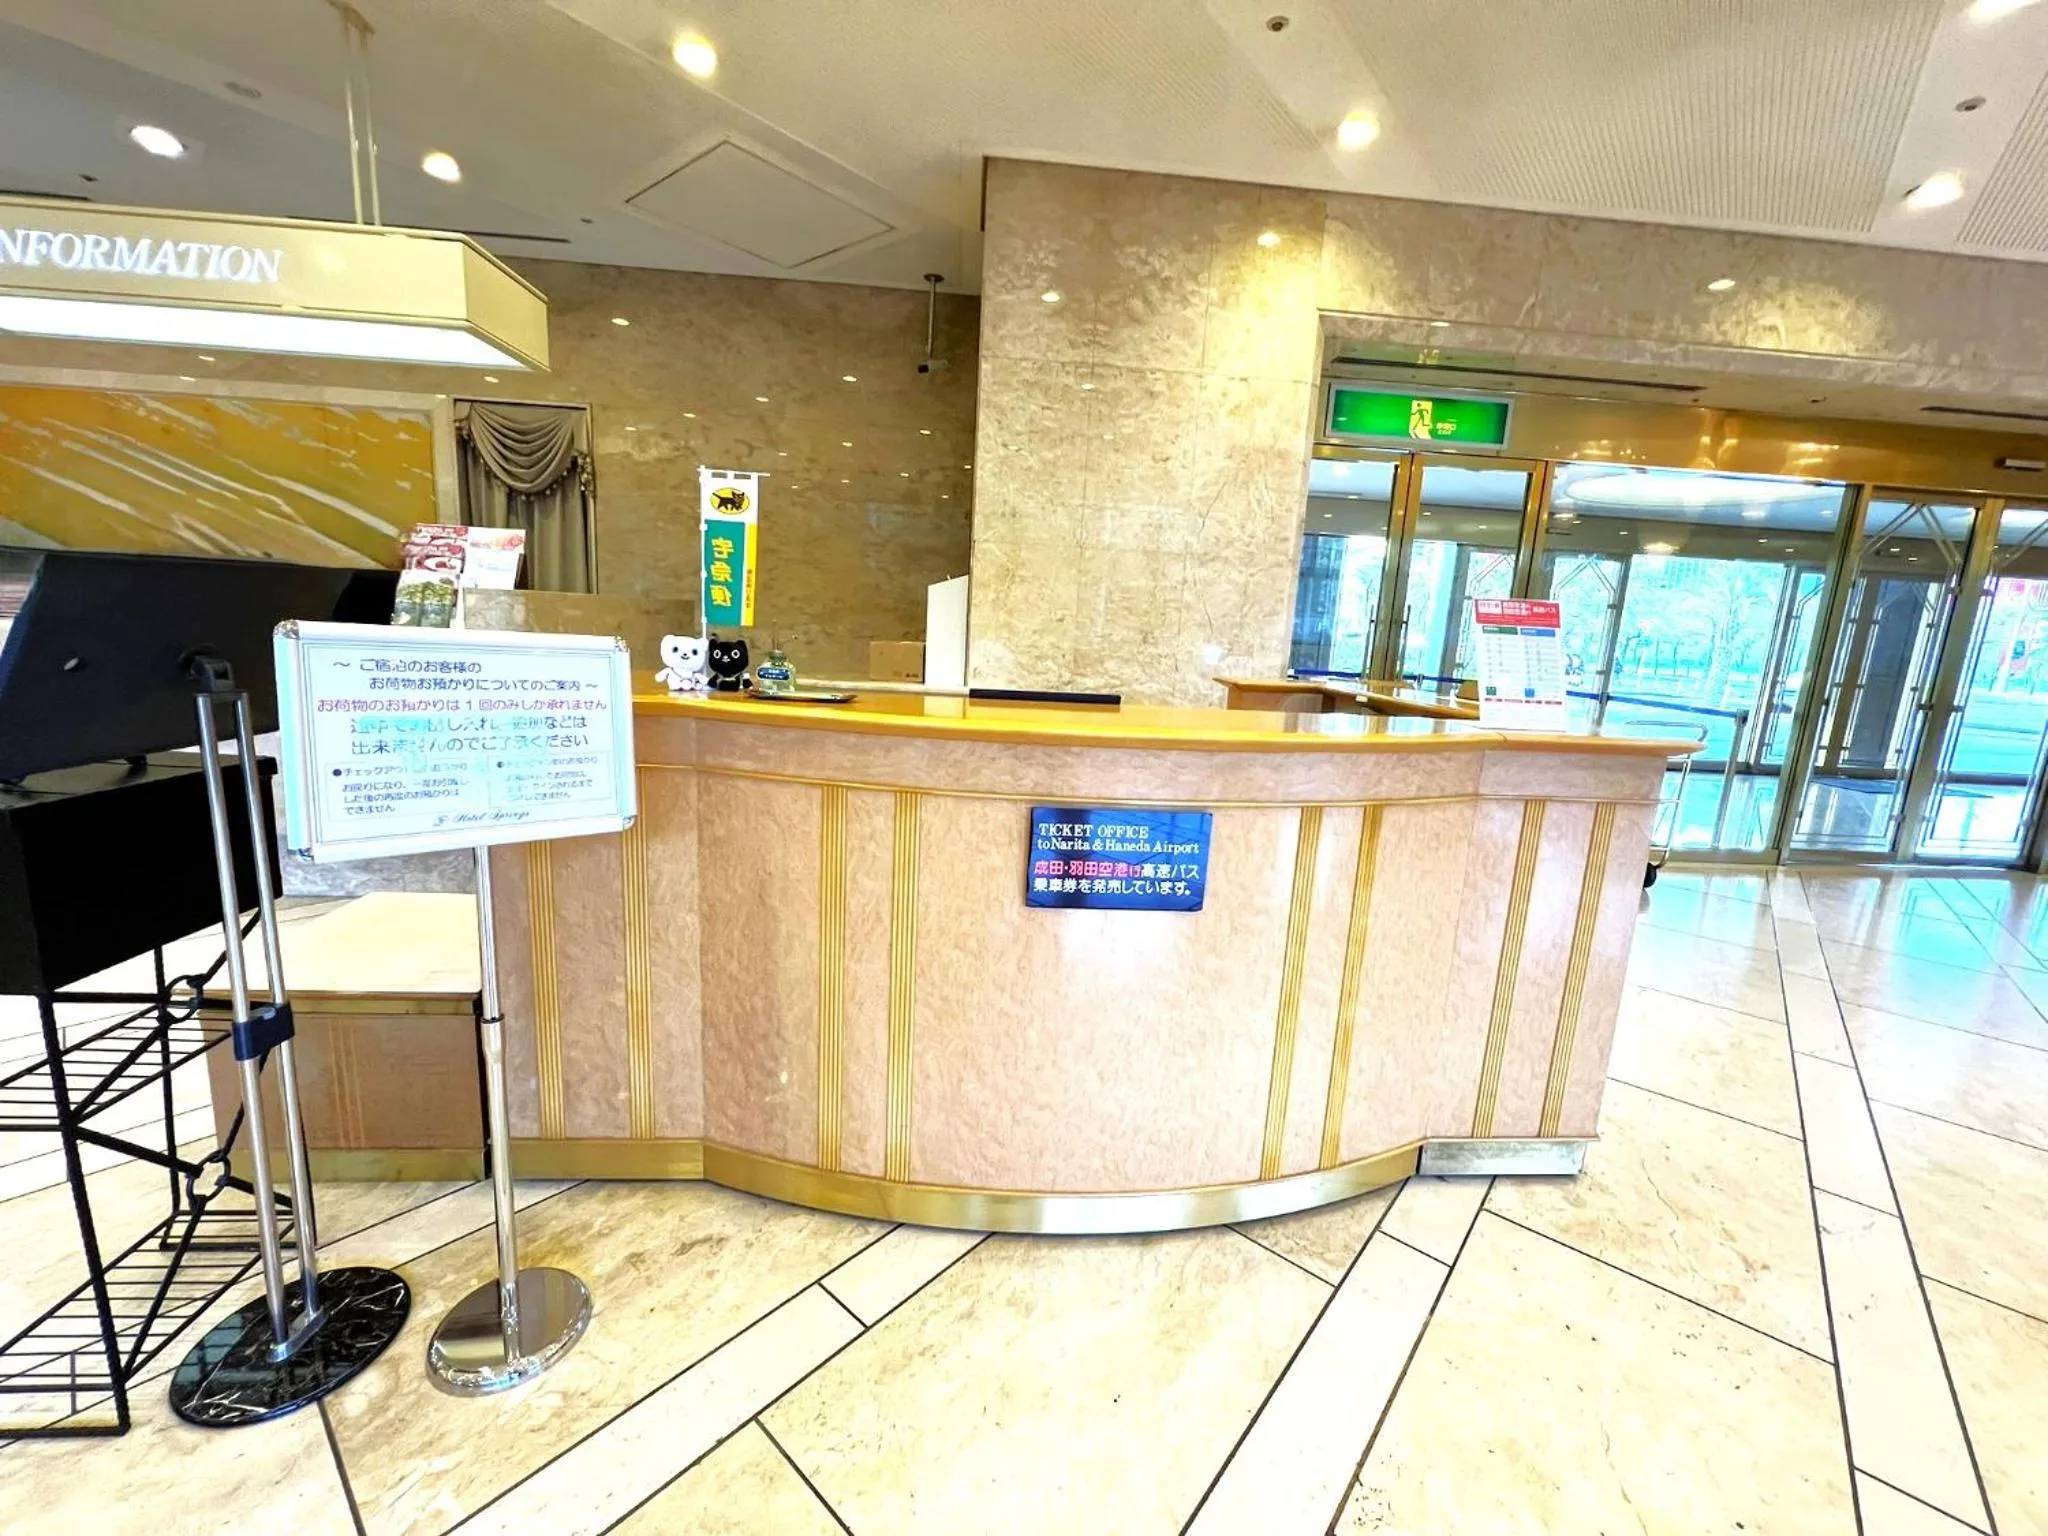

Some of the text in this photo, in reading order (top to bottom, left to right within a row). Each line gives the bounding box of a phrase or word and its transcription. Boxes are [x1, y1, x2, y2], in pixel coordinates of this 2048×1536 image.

[1039, 823, 1150, 839] TICKET OFFICE
[1106, 839, 1150, 852] Haneda
[1153, 840, 1200, 854] Airport
